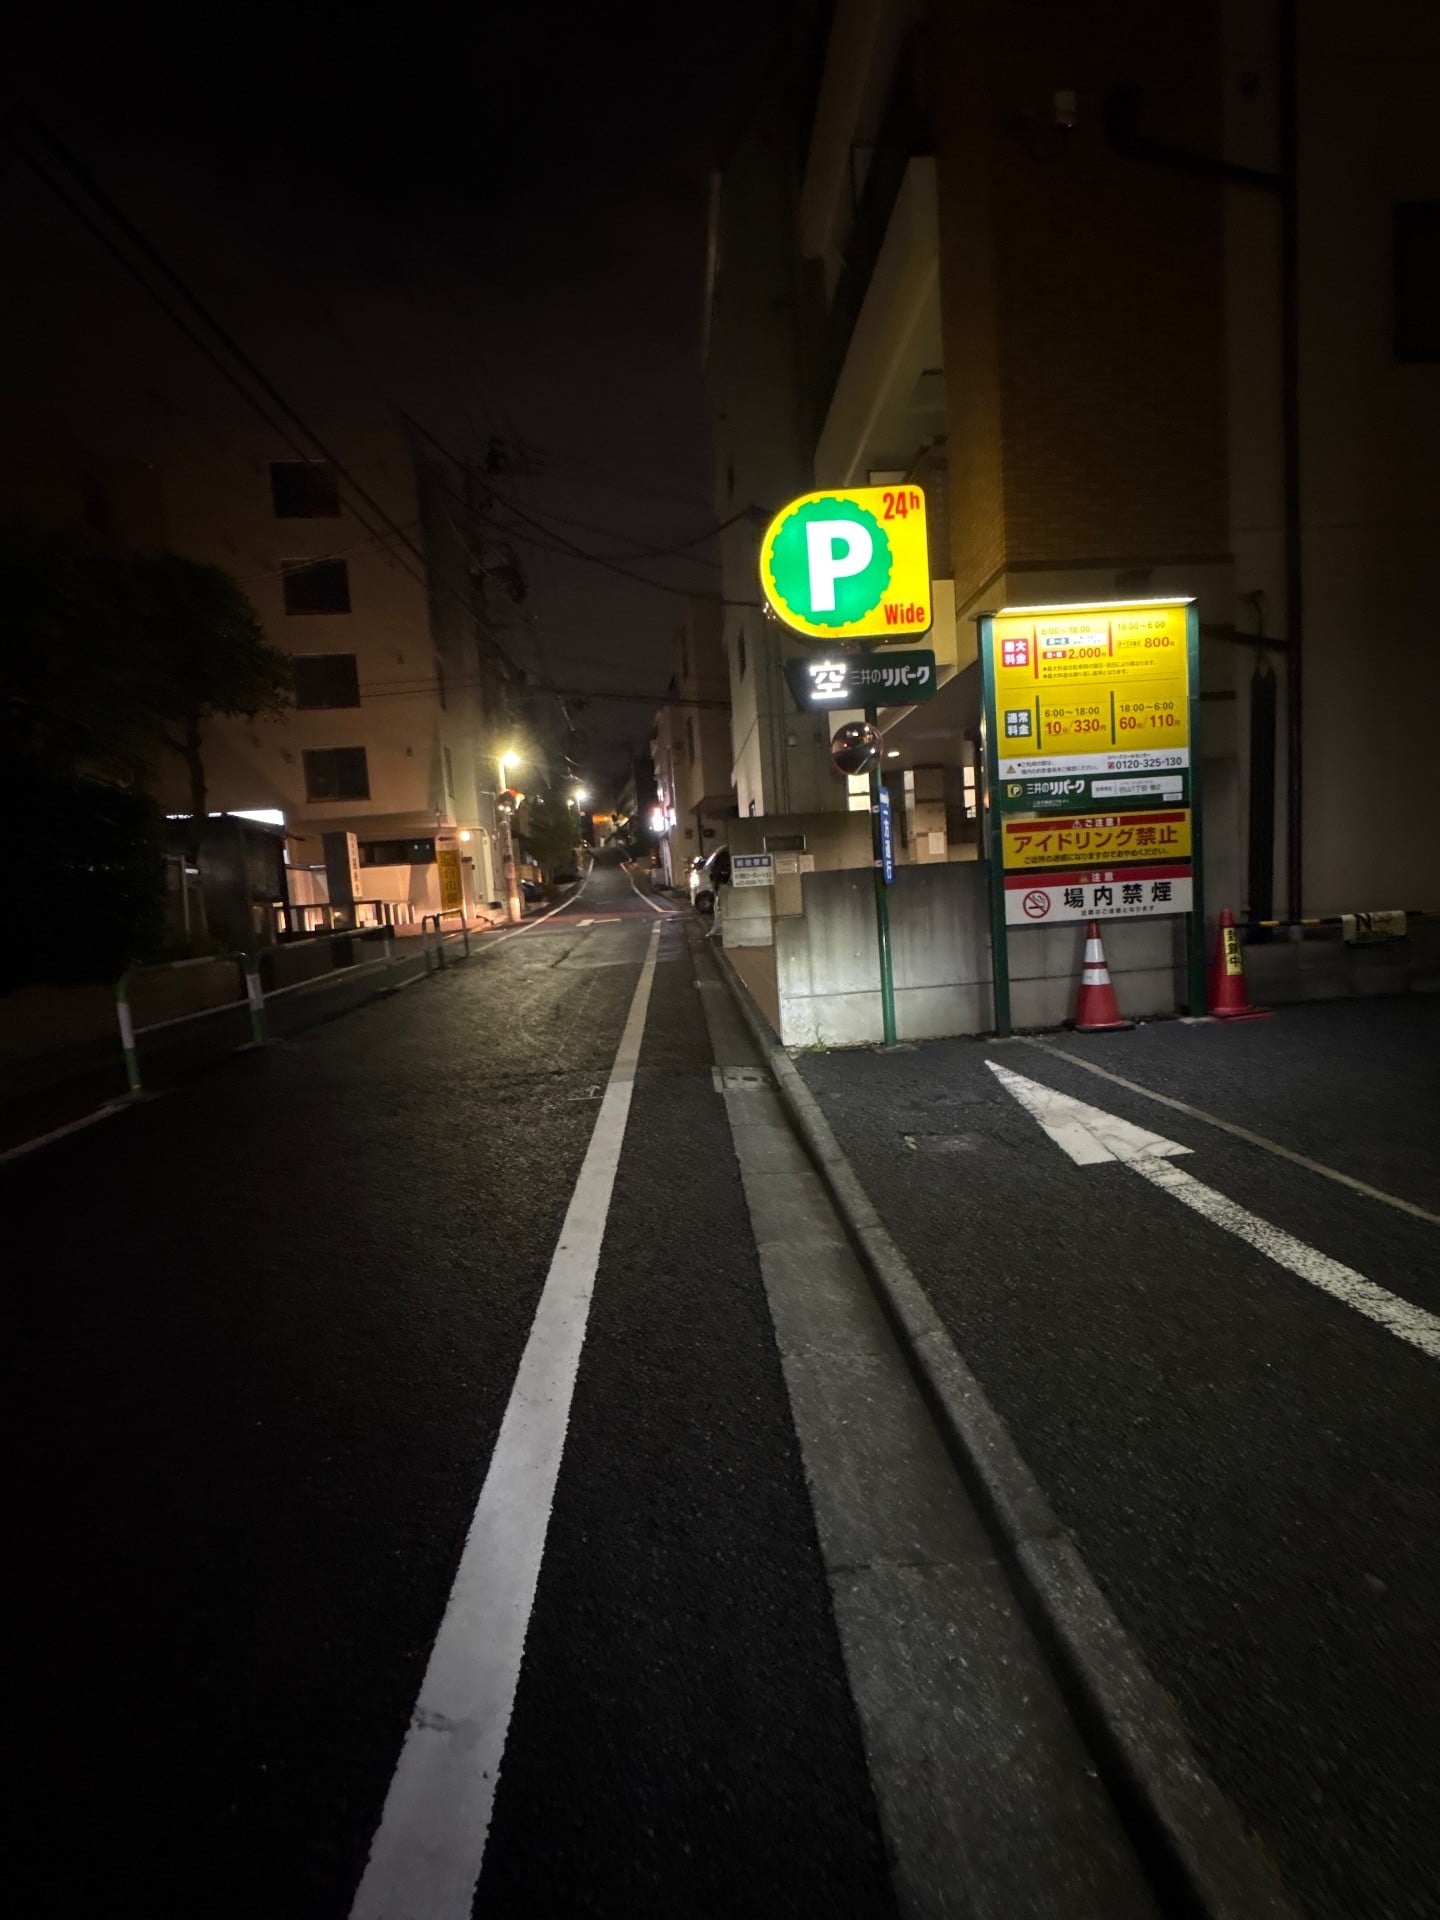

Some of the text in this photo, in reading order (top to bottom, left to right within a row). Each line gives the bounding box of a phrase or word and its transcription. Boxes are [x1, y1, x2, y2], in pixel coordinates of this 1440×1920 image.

[883, 491, 920, 520] 24h
[805, 519, 873, 613] P
[884, 602, 925, 625] Wide
[809, 661, 848, 700] 空
[850, 665, 930, 687] 三井のリパーク
[1115, 756, 1183, 770] 0120-325-130
[1026, 779, 1086, 796] 三井のリパーク
[1013, 825, 1179, 855] アイドリング禁止
[1091, 871, 1115, 882] 注意
[1063, 881, 1173, 909] 場内禁煙
